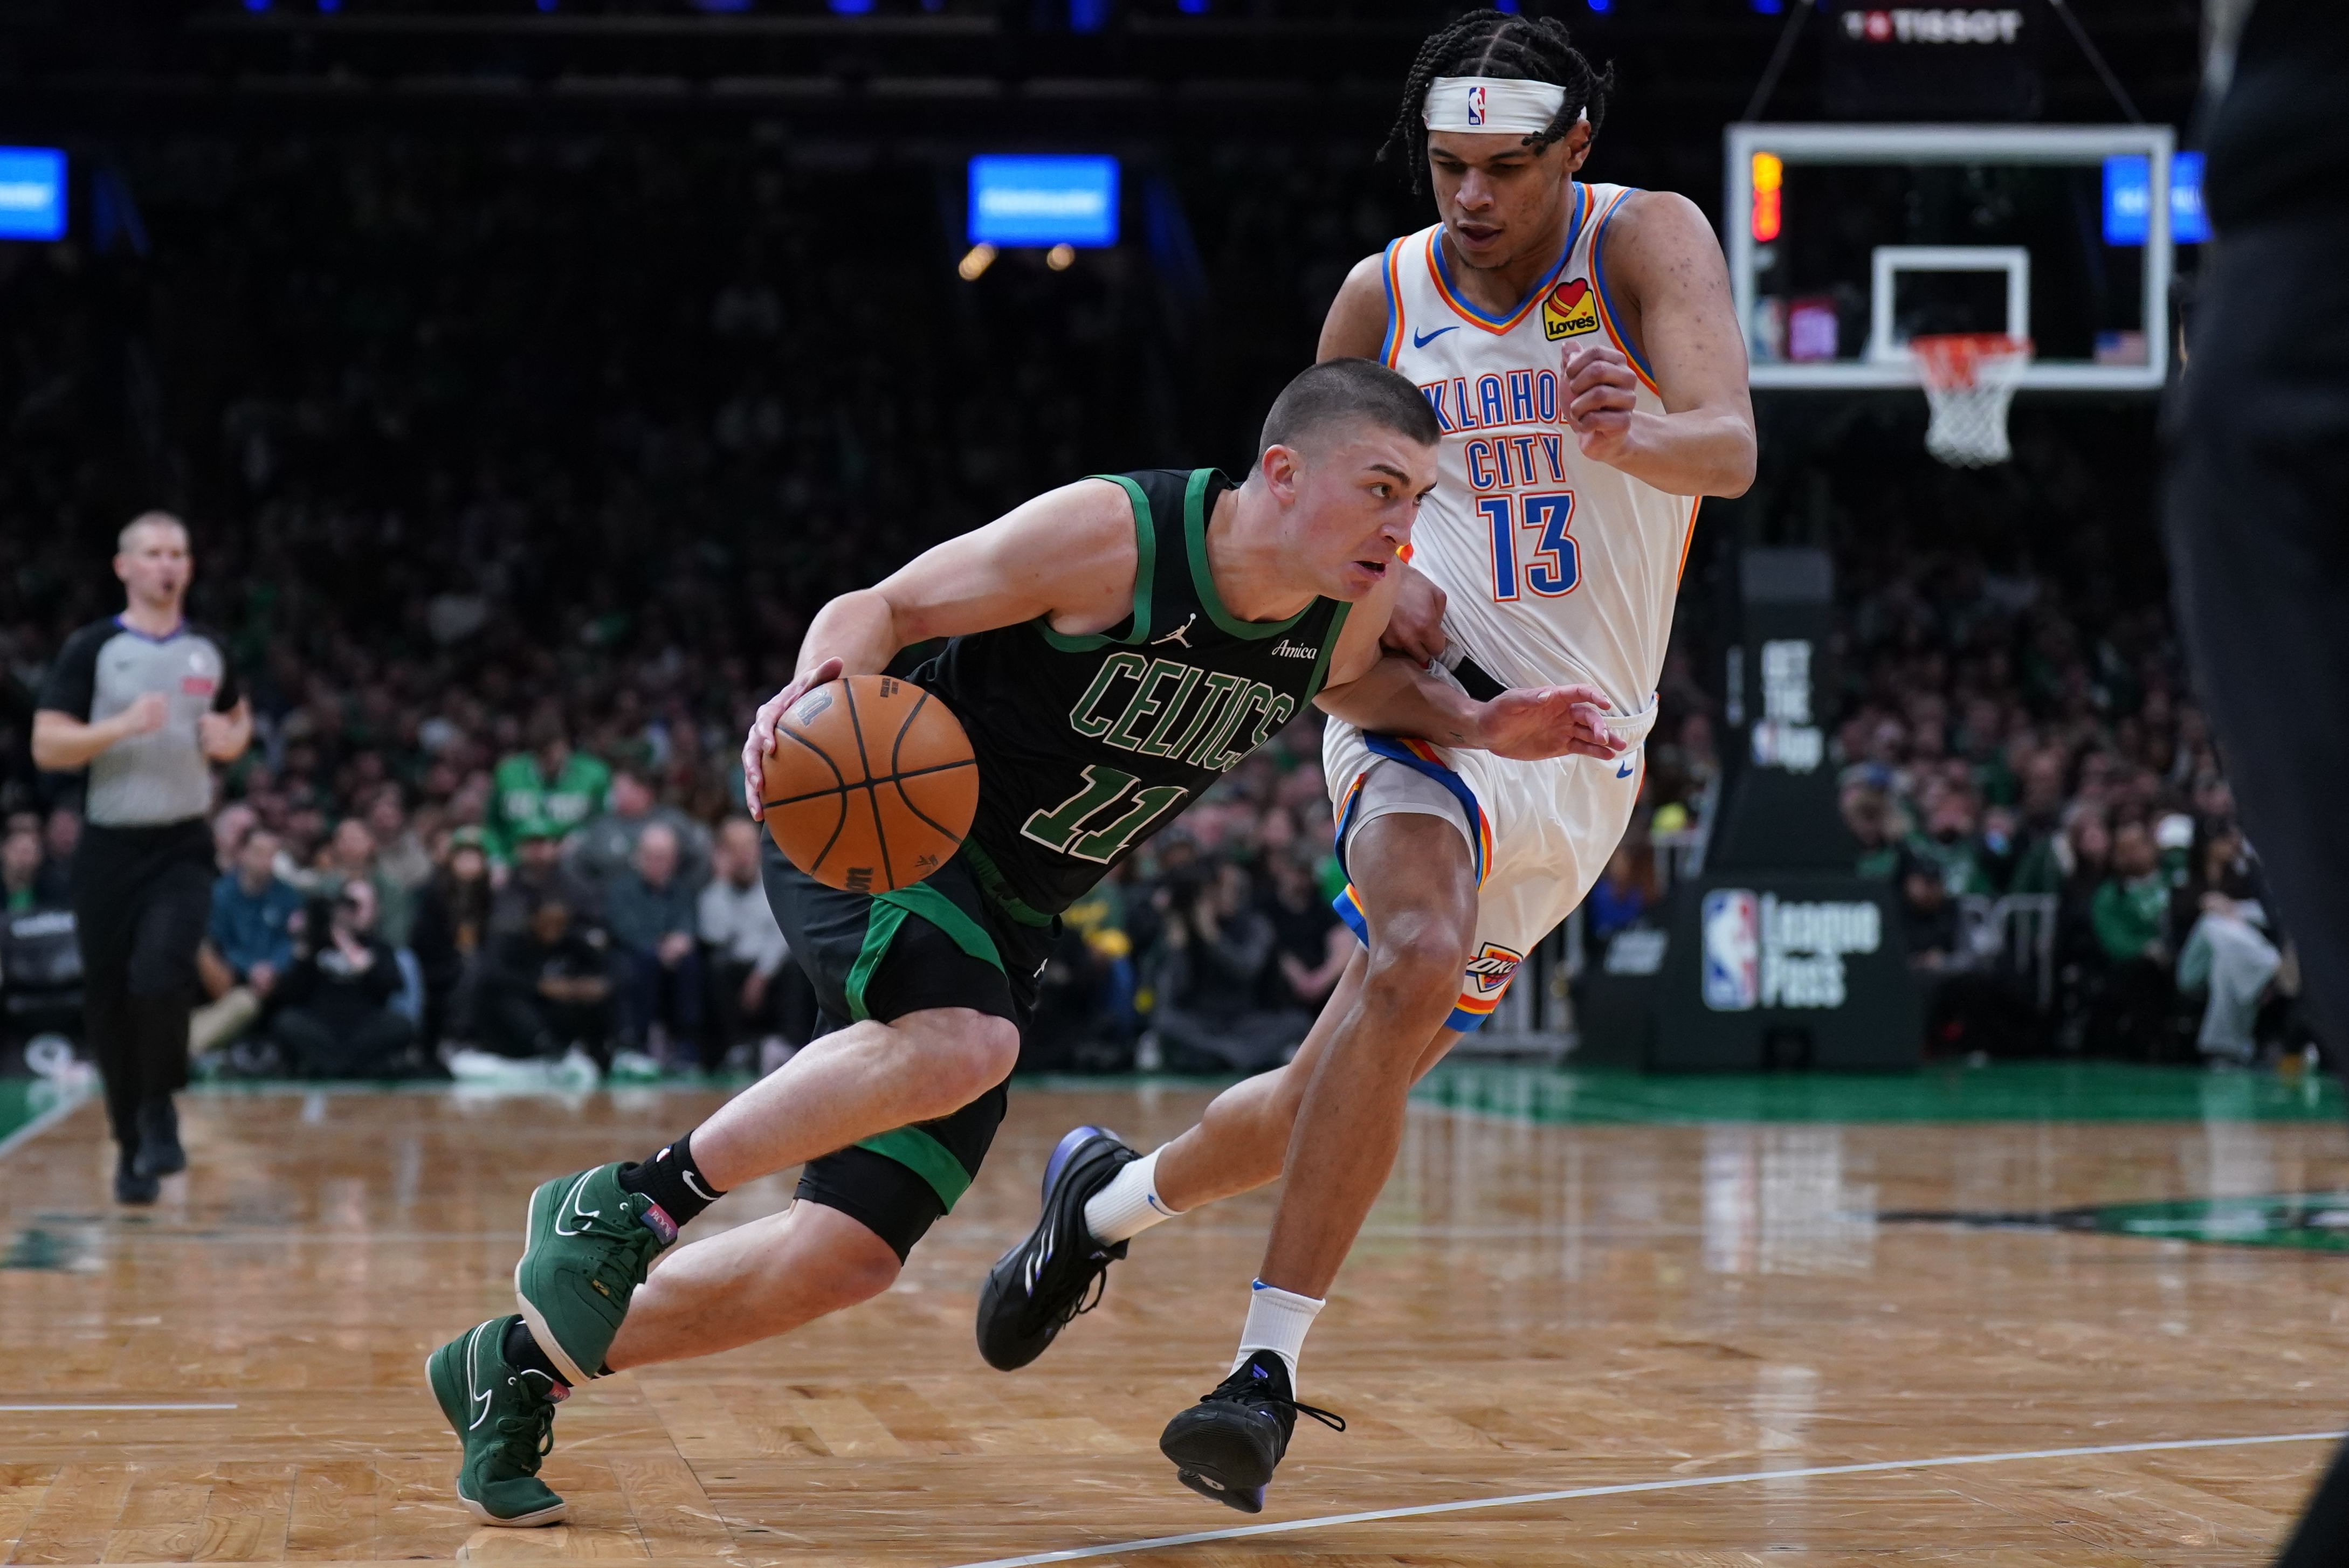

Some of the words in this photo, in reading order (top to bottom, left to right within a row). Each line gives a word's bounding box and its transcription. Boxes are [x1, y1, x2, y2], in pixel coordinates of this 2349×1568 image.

[1890, 8, 2023, 44] TISSOT
[1418, 369, 1569, 435] KLAHO
[1465, 433, 1566, 492] CITY
[1475, 490, 1582, 603] 13
[1271, 639, 1317, 659] Amica
[1069, 651, 1294, 772] CELTICS
[1020, 764, 1189, 864] 11
[1761, 891, 1881, 956] League
[1761, 956, 1846, 1008] Pass
